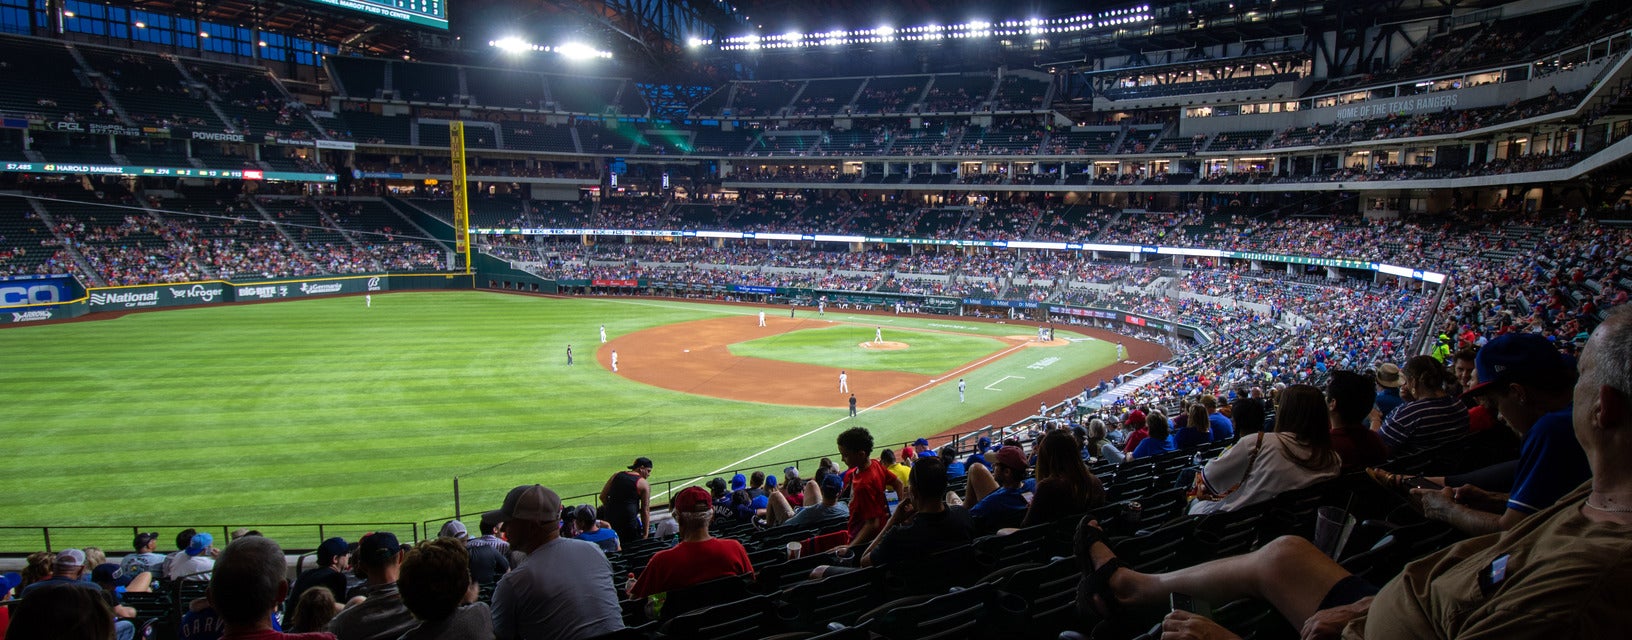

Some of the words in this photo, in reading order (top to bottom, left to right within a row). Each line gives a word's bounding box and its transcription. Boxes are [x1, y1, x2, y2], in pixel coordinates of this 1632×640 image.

[390, 10, 410, 20] CENTER
[1337, 107, 1358, 119] HOME
[1360, 106, 1370, 116] OF
[1372, 103, 1386, 114] THE
[1389, 99, 1414, 112] TEXAS
[1416, 94, 1458, 110] RANGERS
[57, 122, 84, 131] PGL
[192, 131, 244, 142] POWERADE
[56, 164, 89, 172] HAROLD
[90, 165, 123, 173] RAMIREZ
[106, 291, 159, 304] National
[187, 285, 223, 301] Kroger
